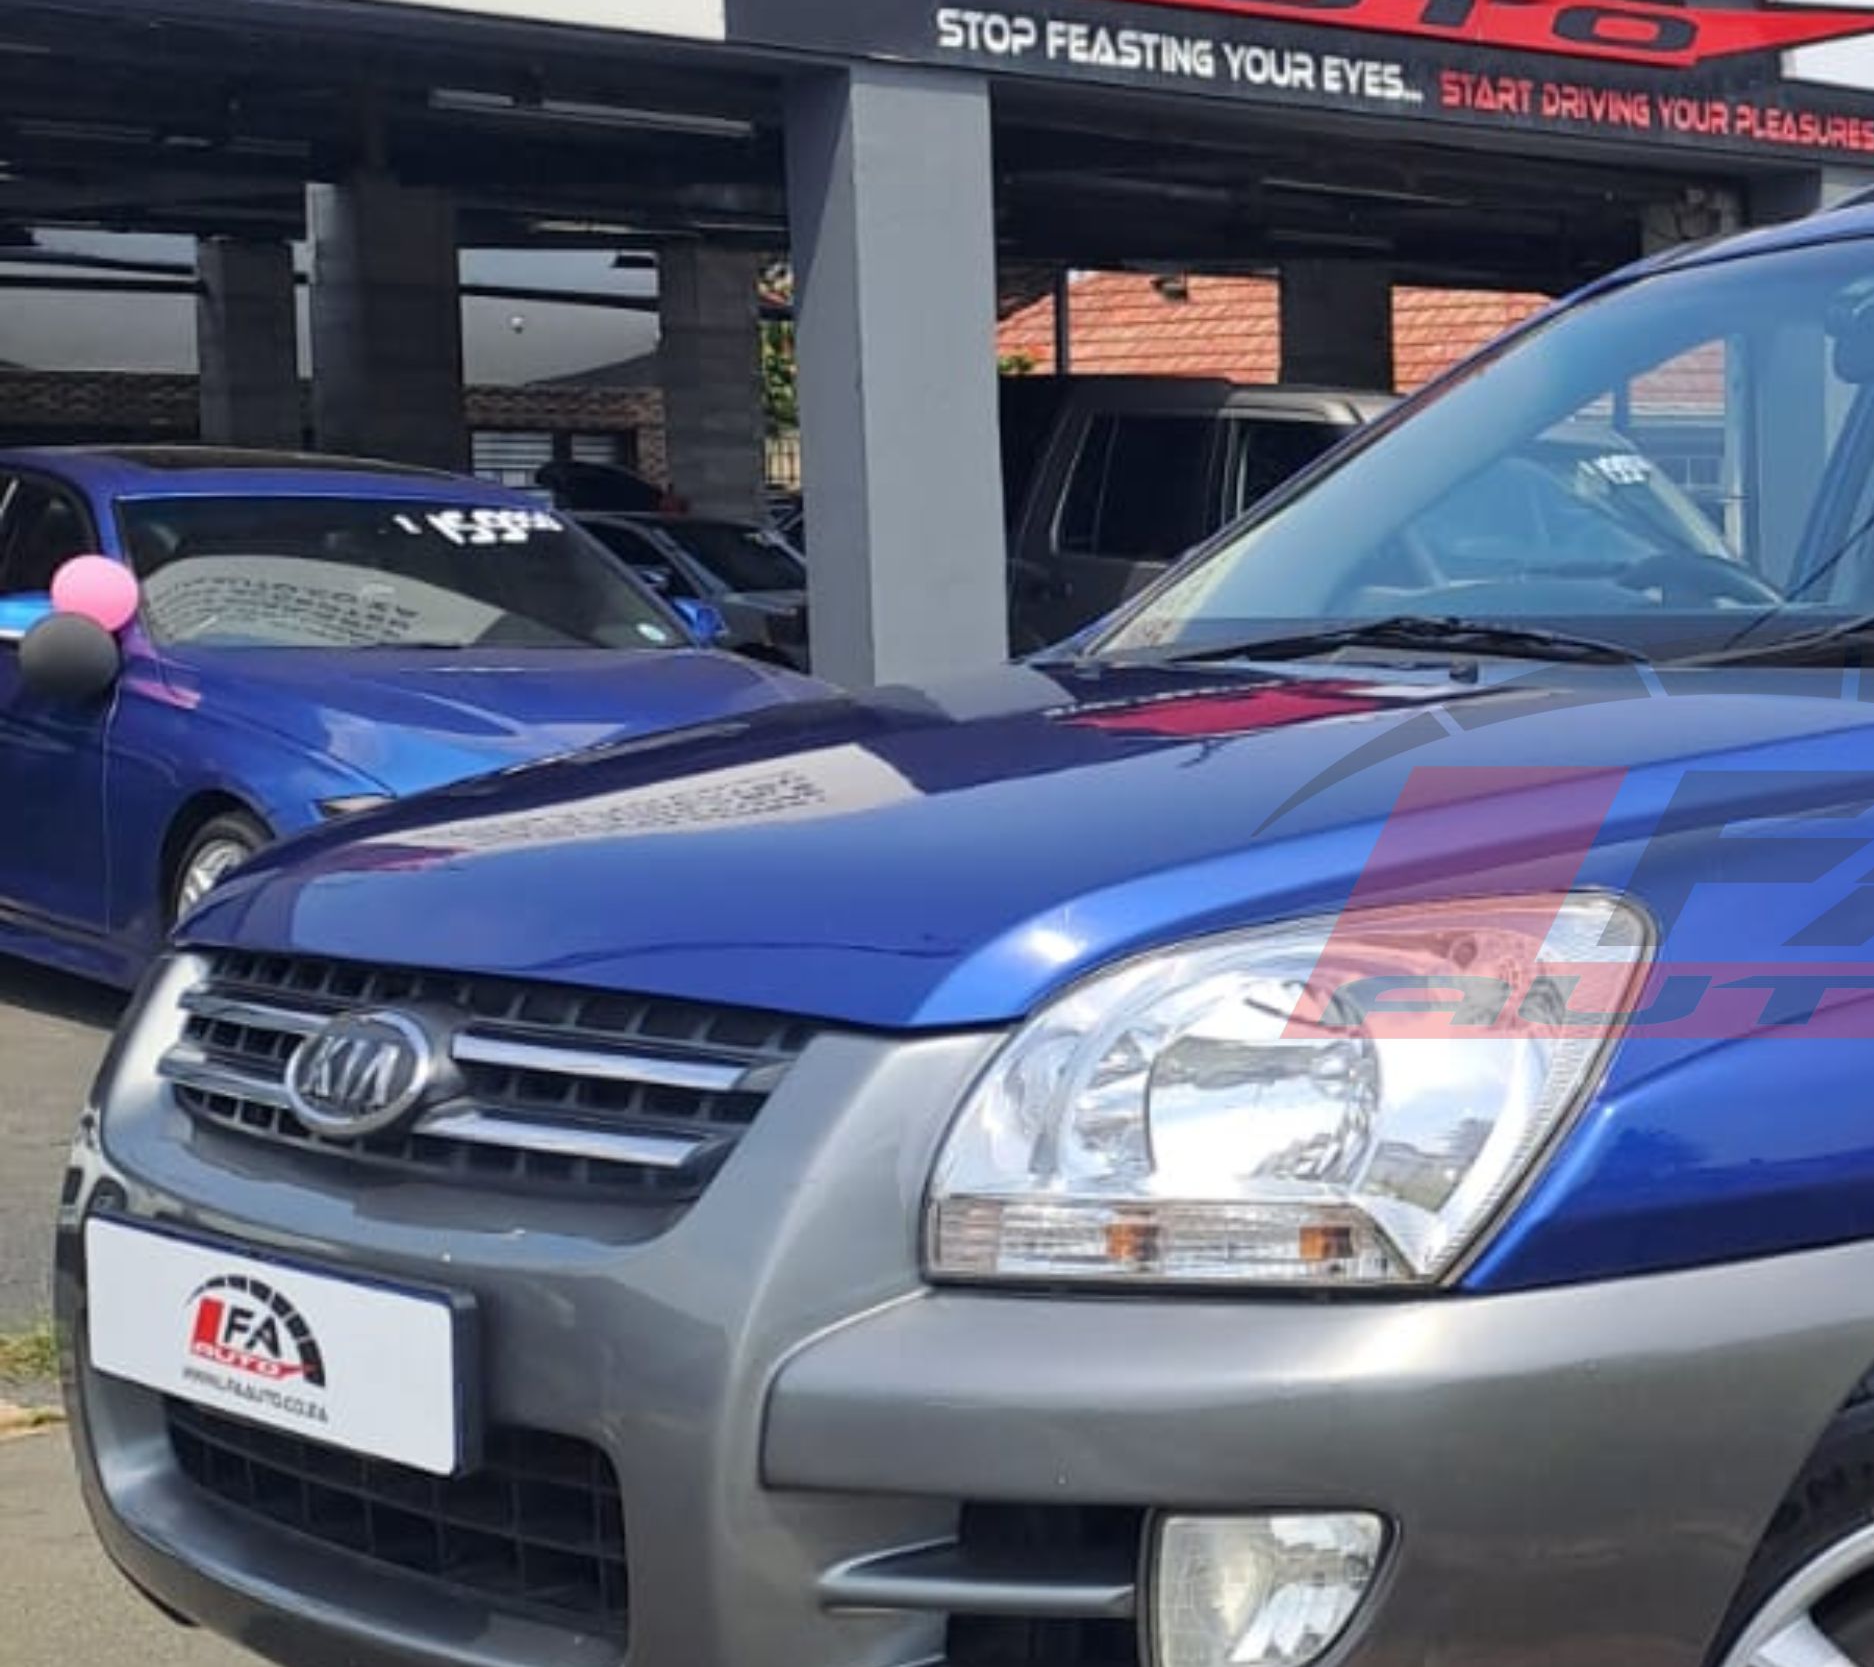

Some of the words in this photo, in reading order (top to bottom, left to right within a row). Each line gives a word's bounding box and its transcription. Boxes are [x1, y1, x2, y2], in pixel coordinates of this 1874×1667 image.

[936, 8, 1036, 54] STOP
[1046, 21, 1215, 77] FEASTING
[1223, 44, 1316, 90] YOUR
[1323, 57, 1424, 102] EYES...
[1439, 71, 1532, 112] START
[1541, 84, 1651, 127] DRIVING
[1657, 99, 1729, 134] YOUR
[300, 1035, 400, 1108] KIA
